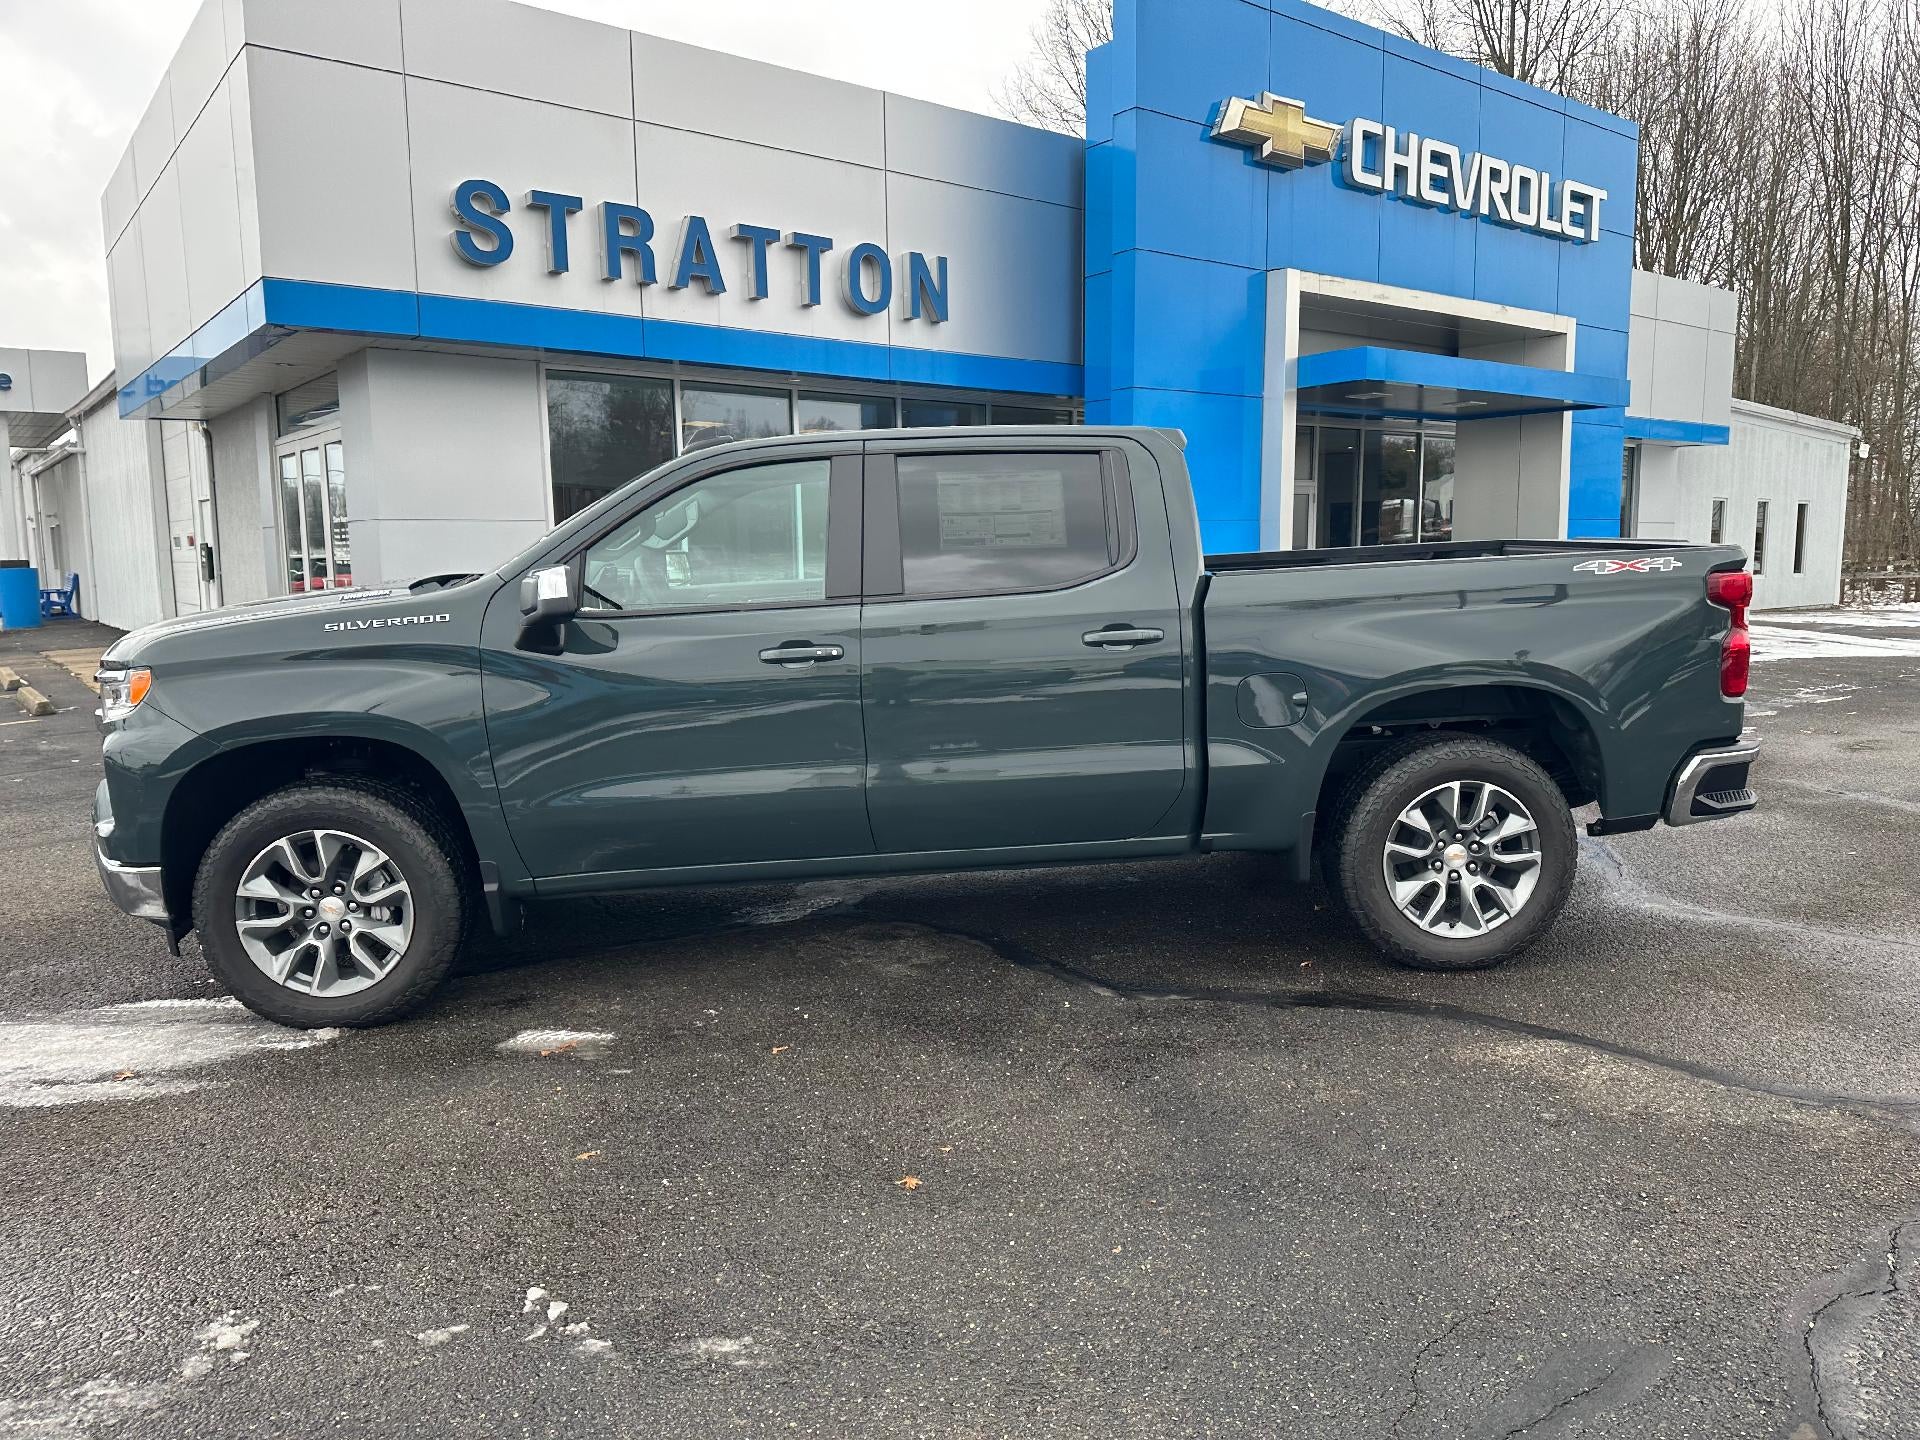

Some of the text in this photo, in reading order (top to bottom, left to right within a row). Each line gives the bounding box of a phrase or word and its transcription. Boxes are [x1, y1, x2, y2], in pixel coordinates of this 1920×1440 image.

[1342, 117, 1608, 243] CHEVROLET
[449, 179, 949, 323] STRATTON
[323, 613, 450, 632] SILVERADO
